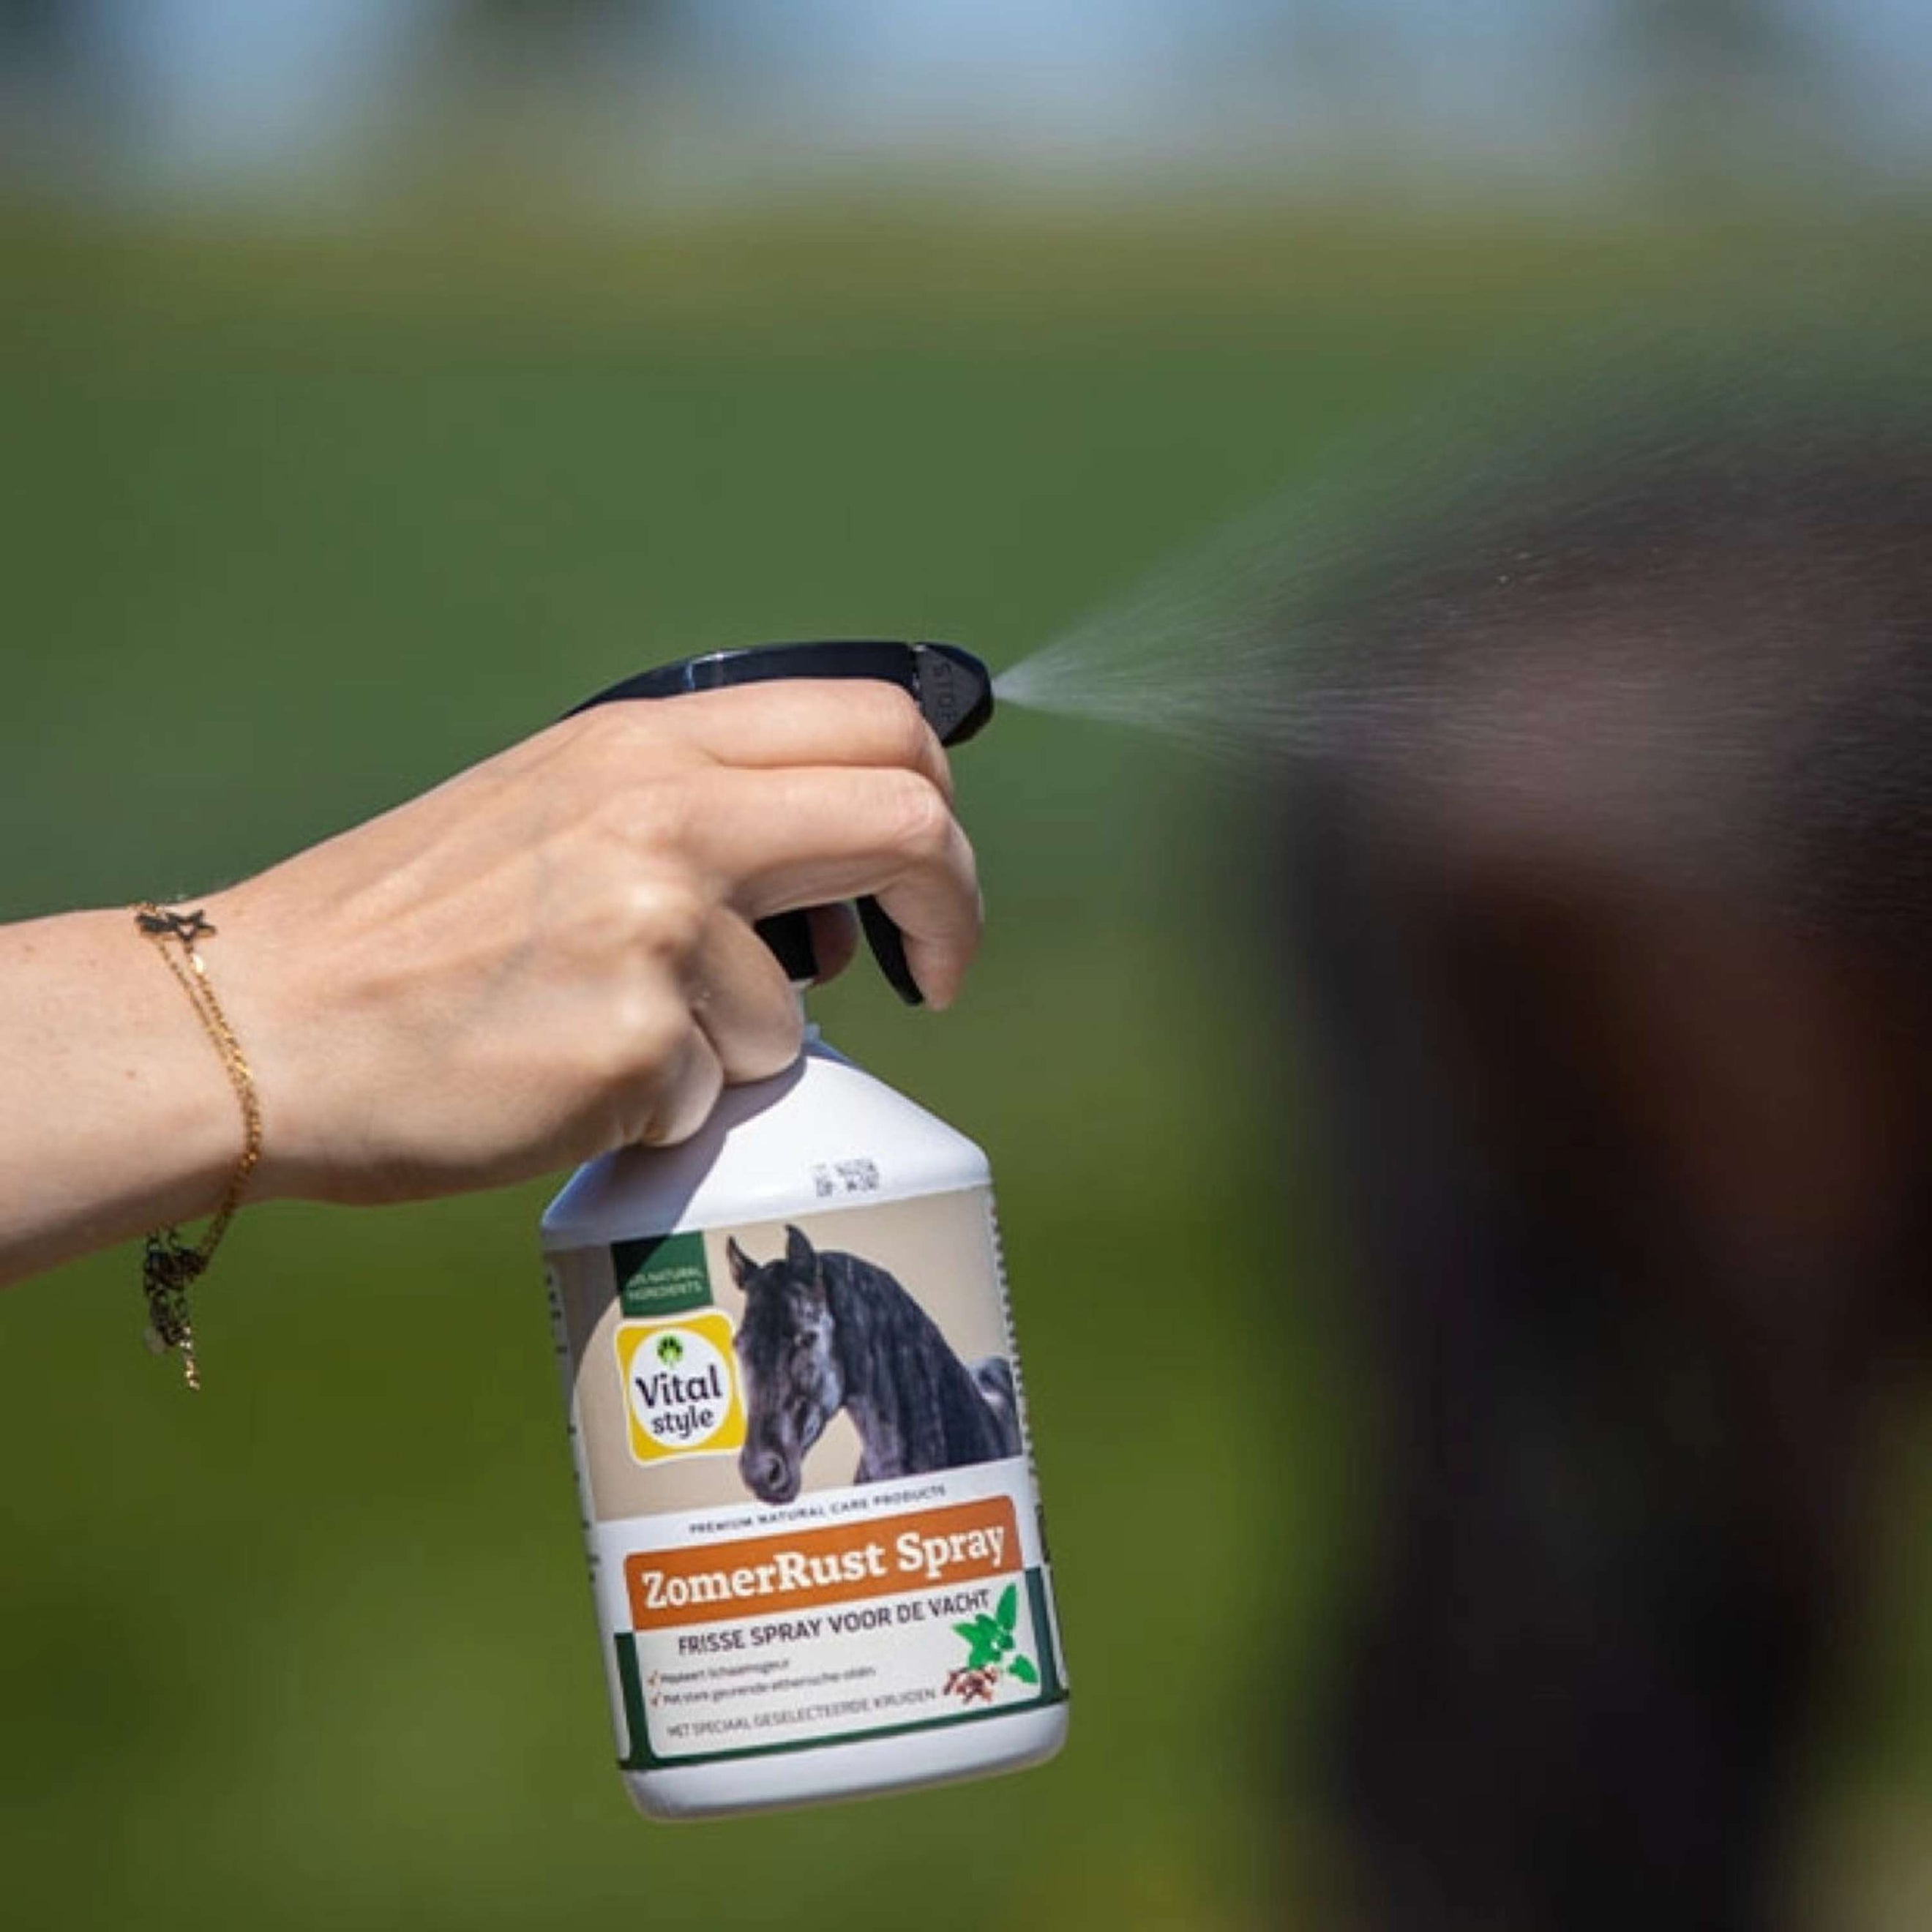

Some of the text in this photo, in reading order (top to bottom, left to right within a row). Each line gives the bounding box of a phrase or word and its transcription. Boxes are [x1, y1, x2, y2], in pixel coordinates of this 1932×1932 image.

[635, 1364, 722, 1408] Vital
[651, 1404, 714, 1439] style
[643, 1544, 887, 1609] ZomerRust
[896, 1525, 1005, 1580] Spray
[678, 1588, 991, 1656] FRISSE SPRAY VOOR DE VACHT
